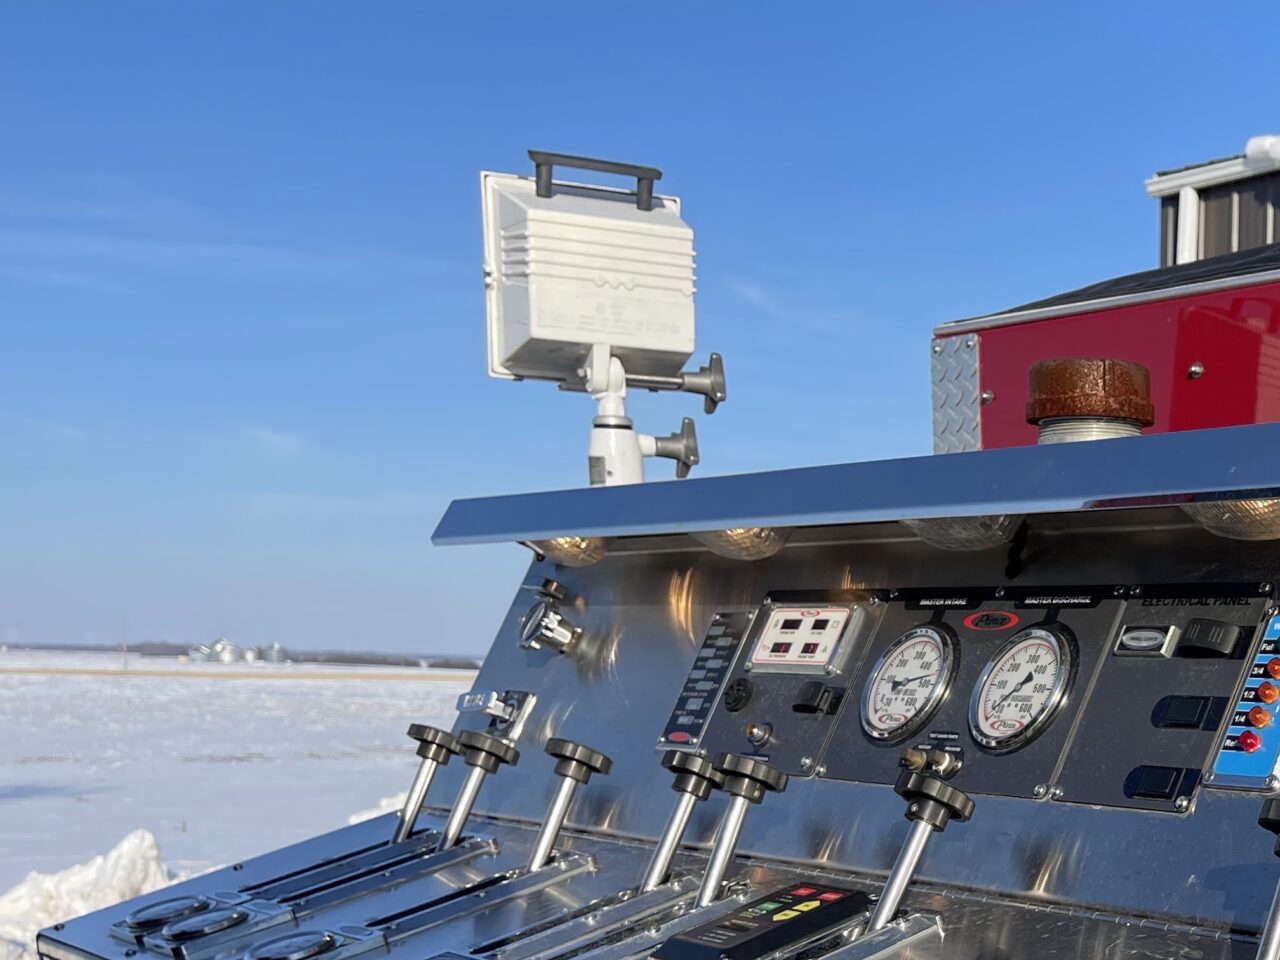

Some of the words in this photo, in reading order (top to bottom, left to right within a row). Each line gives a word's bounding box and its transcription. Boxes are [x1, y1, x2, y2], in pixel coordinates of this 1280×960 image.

[1024, 596, 1051, 604] MASTER
[1141, 597, 1210, 606] ELECTRICAL
[1212, 596, 1252, 606] PANEL
[1026, 654, 1040, 663] 300
[1007, 663, 1021, 672] 200
[1033, 664, 1047, 674] 400
[918, 679, 931, 688] 500
[1032, 684, 1046, 693] 500
[1019, 703, 1032, 713] 600
